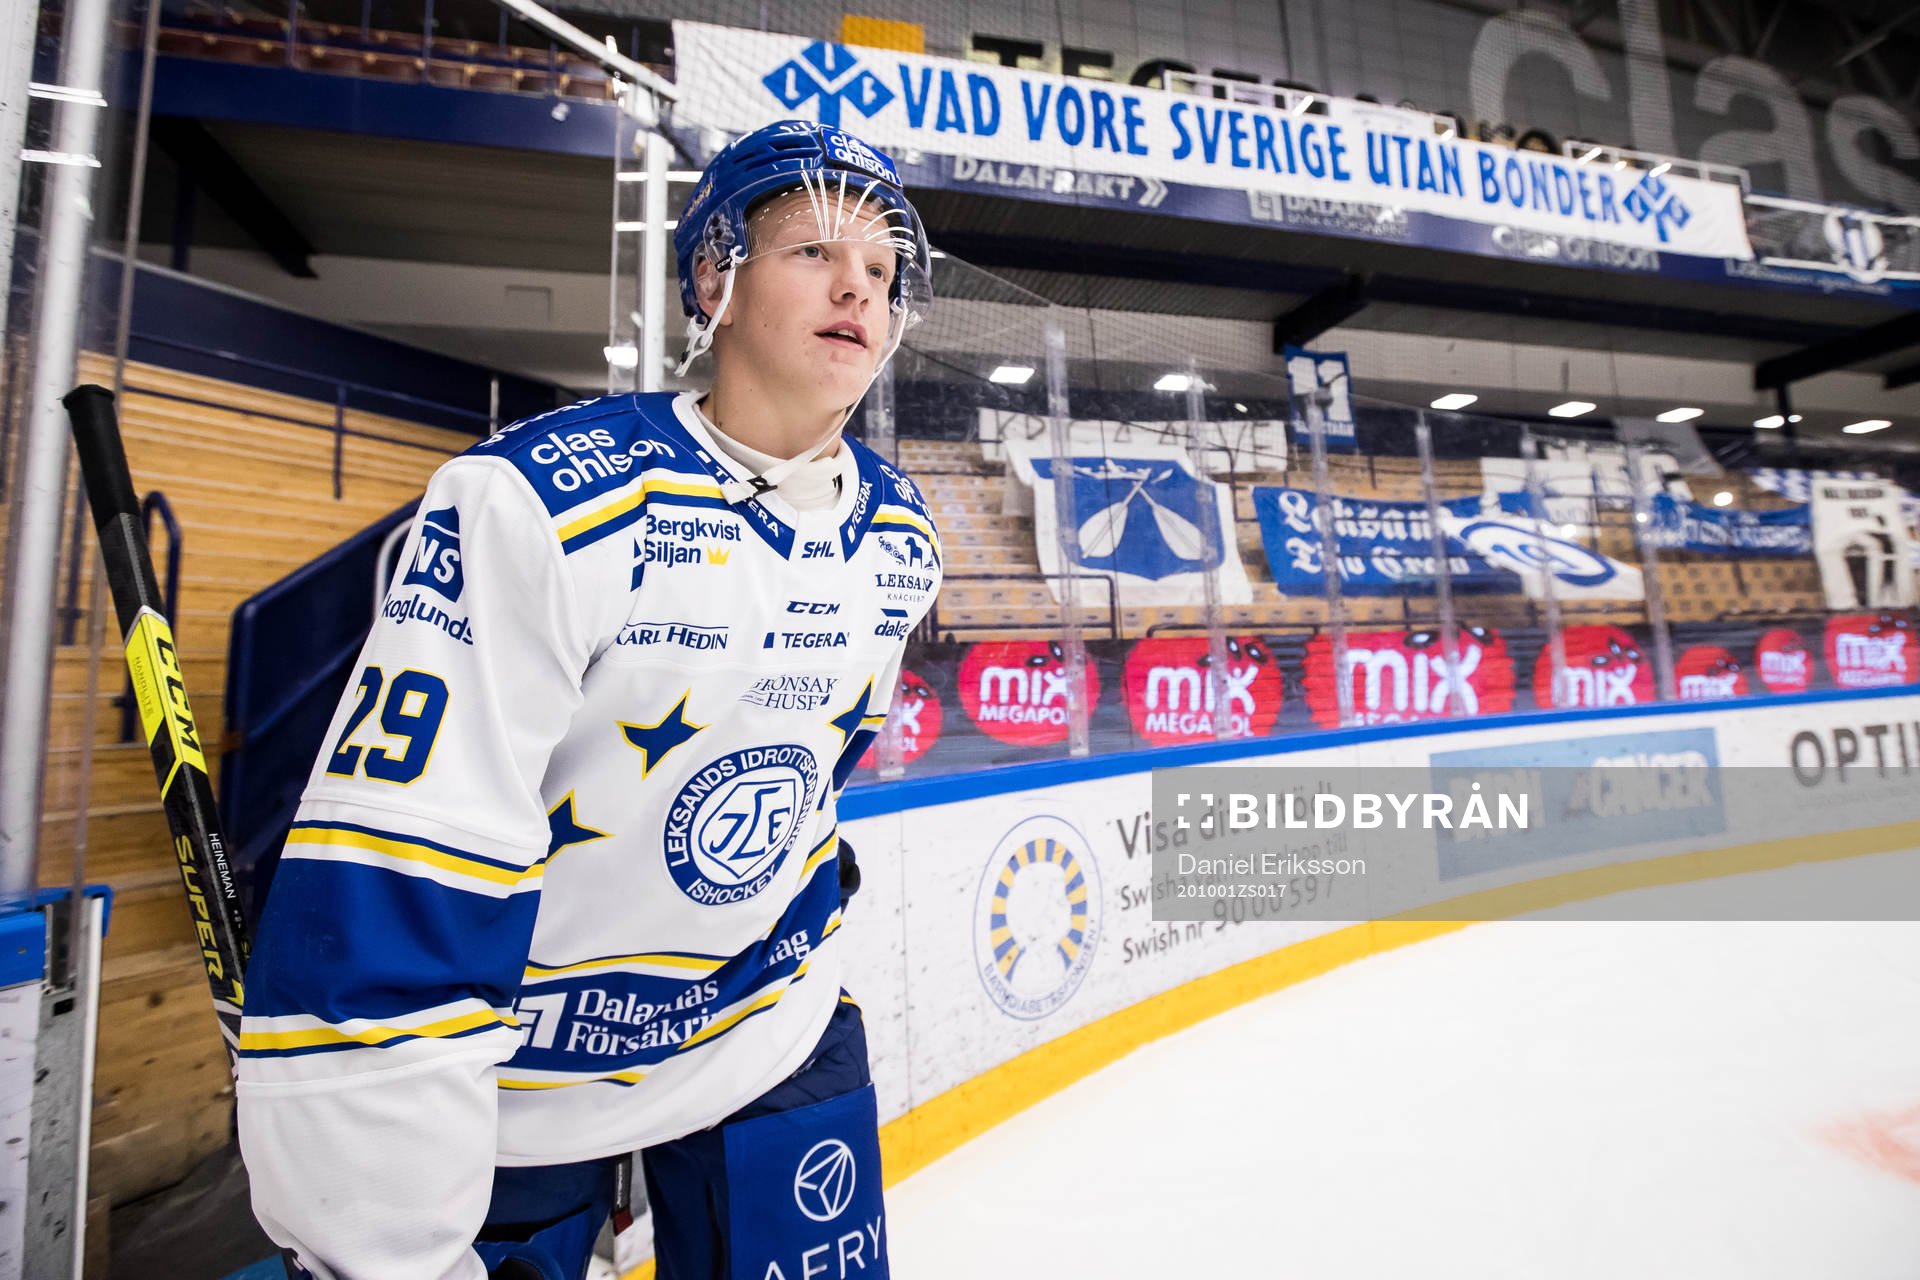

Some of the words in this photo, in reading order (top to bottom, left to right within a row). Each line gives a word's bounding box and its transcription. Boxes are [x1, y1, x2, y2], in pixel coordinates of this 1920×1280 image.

[898, 63, 1000, 137] VAD
[1021, 80, 1150, 156] VORE
[1171, 88, 1351, 182] SVERIGE
[1366, 130, 1464, 198] UTAN
[954, 154, 1135, 200] DALAFRAKT
[531, 428, 616, 465] clas
[552, 439, 676, 492] ohlson
[714, 465, 780, 539] TERA
[647, 514, 742, 542] Bergkvist
[801, 541, 835, 559] SHL
[644, 540, 701, 568] Siljan
[786, 600, 841, 615] CCM
[666, 626, 729, 650] HEDIN
[781, 631, 848, 649] TEGERA
[156, 636, 202, 753] CCM
[979, 665, 1076, 706] mix
[1145, 663, 1259, 716] mix
[1341, 643, 1482, 717] mix
[325, 664, 450, 787] 29
[1144, 711, 1255, 738] MEGAOL
[667, 758, 737, 867] LEKSANDS
[1116, 811, 1189, 860] Visa
[208, 832, 237, 899] HEINEMAN
[686, 864, 776, 905] ISHOCKEY
[175, 833, 225, 981] SUPER
[1122, 920, 1180, 965] Swish
[1185, 919, 1205, 943] nr
